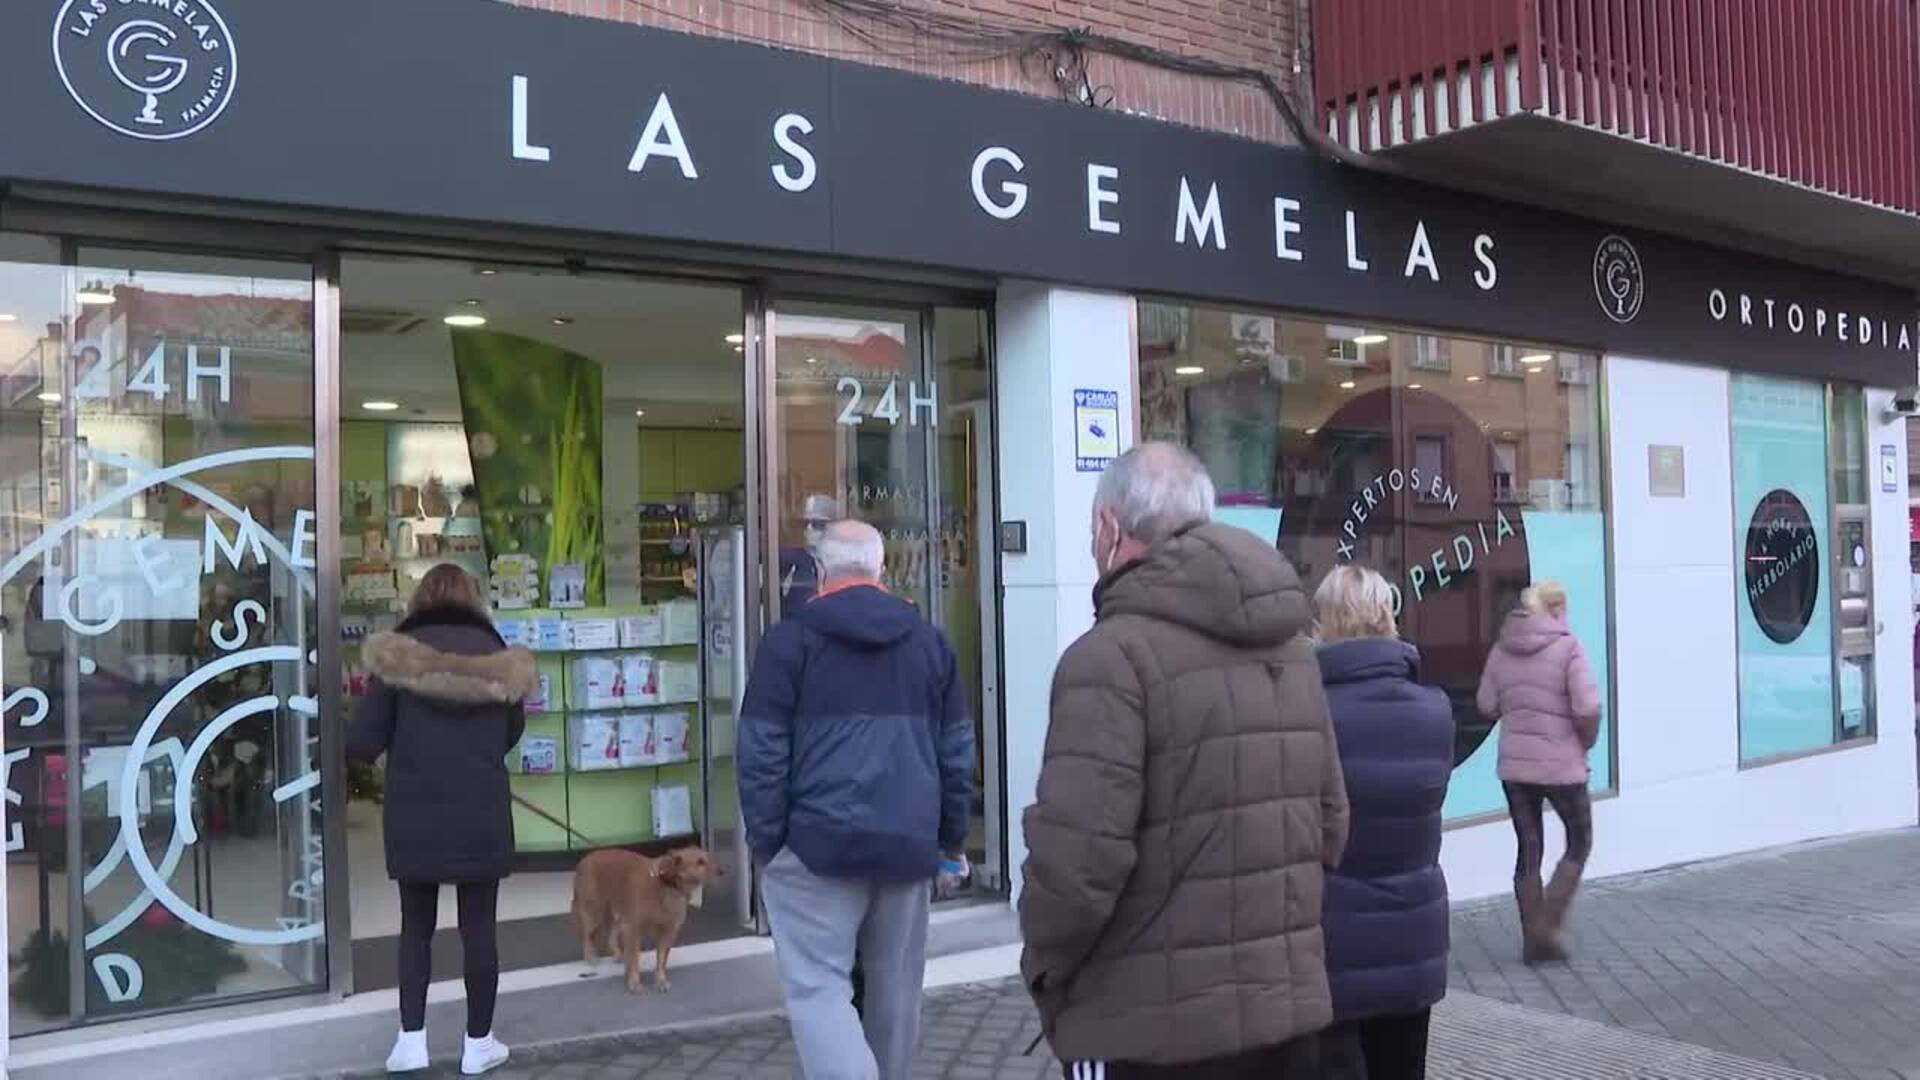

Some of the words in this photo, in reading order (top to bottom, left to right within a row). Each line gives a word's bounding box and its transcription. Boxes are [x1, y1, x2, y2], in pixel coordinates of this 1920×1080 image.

[181, 66, 225, 122] FARMACIA
[512, 75, 817, 192] LAS
[971, 146, 1497, 291] GEMELAS
[1708, 288, 1911, 350] ORTOPEDIA
[72, 339, 231, 403] 24H
[836, 376, 938, 427] 24H
[1431, 474, 1459, 513] EN
